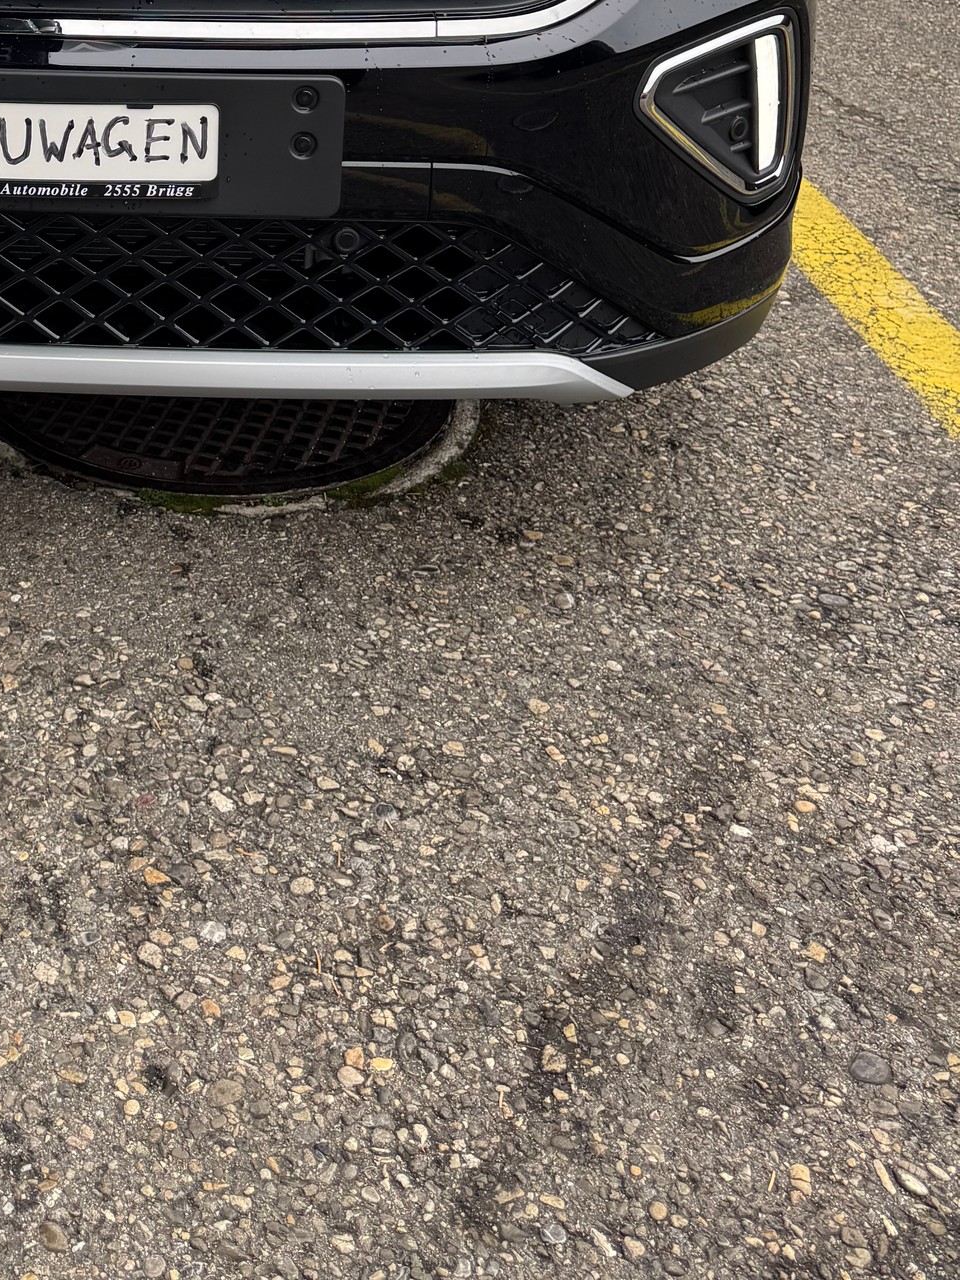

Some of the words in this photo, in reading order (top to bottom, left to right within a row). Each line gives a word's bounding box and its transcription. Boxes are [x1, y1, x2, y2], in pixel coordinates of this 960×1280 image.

[0, 183, 88, 196] Automobile
[103, 184, 140, 197] 2555
[146, 184, 194, 198] Brügg
